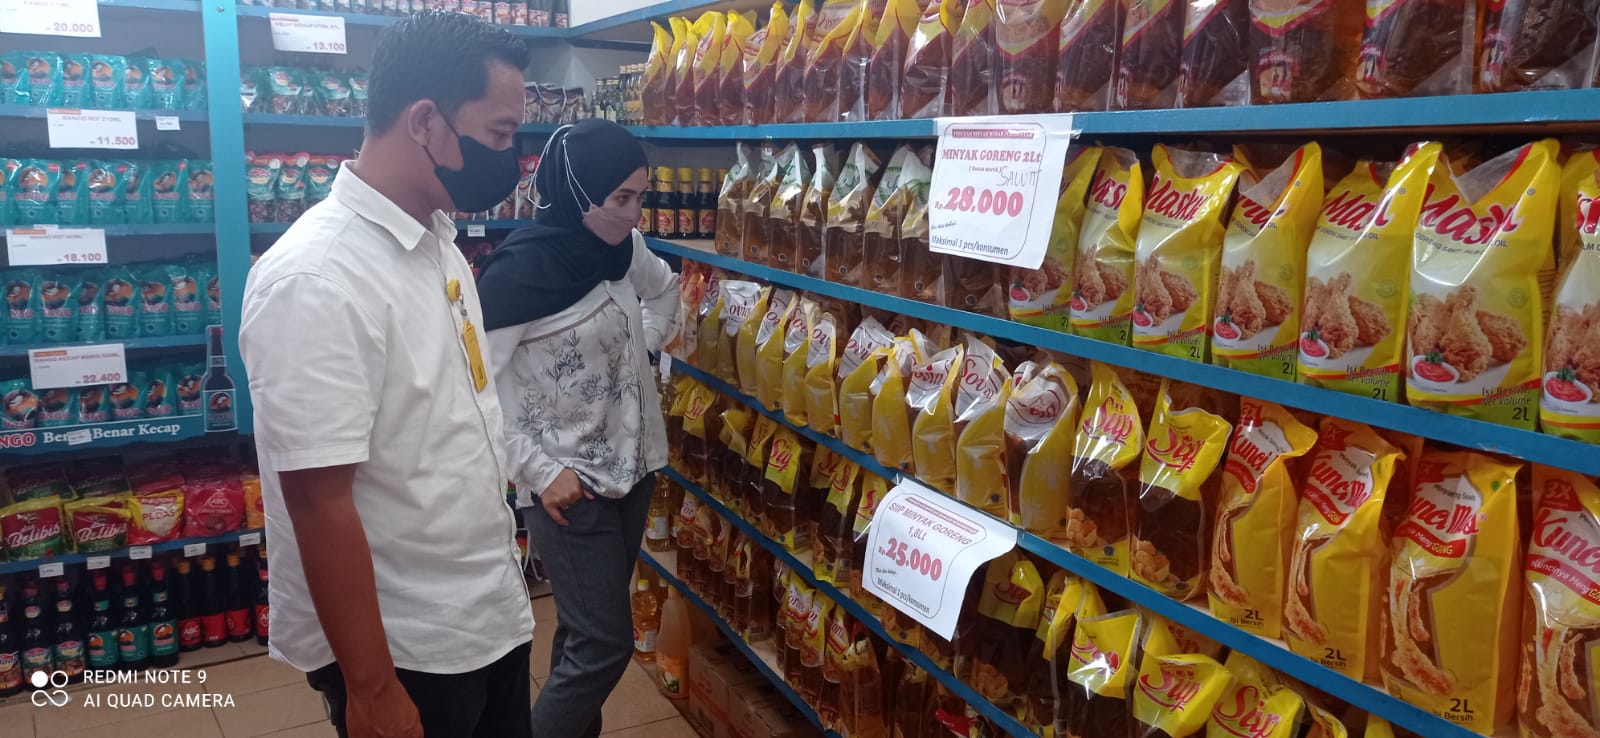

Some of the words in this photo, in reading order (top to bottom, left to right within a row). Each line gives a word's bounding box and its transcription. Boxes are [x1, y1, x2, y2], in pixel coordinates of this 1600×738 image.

[53, 22, 94, 33] 20.000
[312, 41, 345, 51] 13.100
[97, 136, 136, 146] 11.500
[942, 148, 977, 161] MINYAK
[980, 150, 1021, 162] GORENG
[1022, 151, 1042, 163] 2Lt
[944, 185, 1024, 218] 28.000
[931, 235, 959, 247] Maksimal
[962, 240, 1009, 256] pcs/konsumen
[64, 253, 102, 262] 18.100
[83, 373, 121, 384] 22.400
[1512, 407, 1530, 421] 2L
[92, 427, 135, 440] Benar
[138, 424, 181, 437] Kecap
[1231, 424, 1273, 472] Kunci
[142, 510, 176, 521] PEDAS
[78, 522, 128, 542] Belibis
[903, 508, 934, 527] MINYAK
[932, 523, 972, 545] GORENG
[8, 524, 60, 548] Belibis
[1534, 508, 1600, 574] Kunc
[886, 537, 942, 581] 25.000
[877, 577, 897, 594] Maksimal
[1244, 608, 1264, 621] 2L
[1325, 647, 1346, 661] 2L
[1450, 698, 1475, 714] 2L
